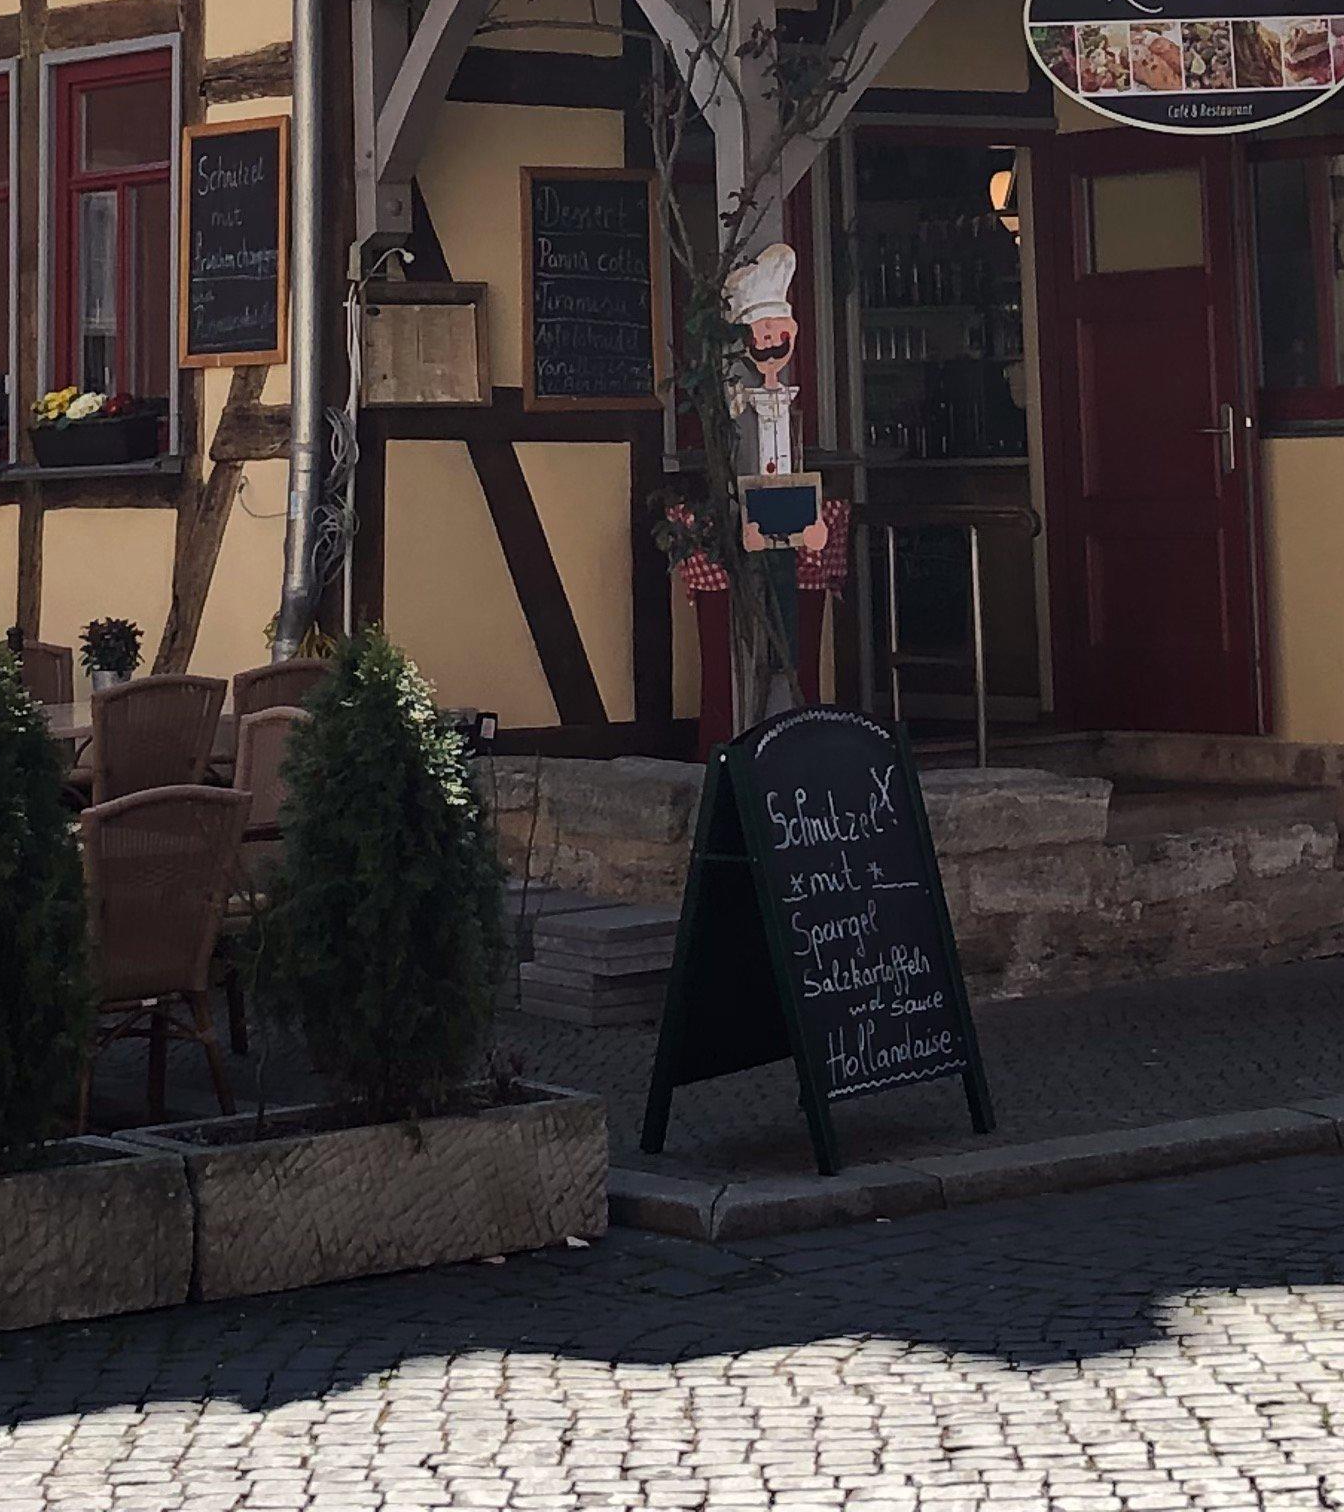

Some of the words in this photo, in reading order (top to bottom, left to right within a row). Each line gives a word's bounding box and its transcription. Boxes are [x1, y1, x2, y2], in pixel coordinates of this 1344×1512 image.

[1200, 103, 1254, 119] Restaurant
[792, 899, 881, 971] Spargel
[803, 944, 931, 998] Salzkartoffeln
[848, 985, 886, 1016] und
